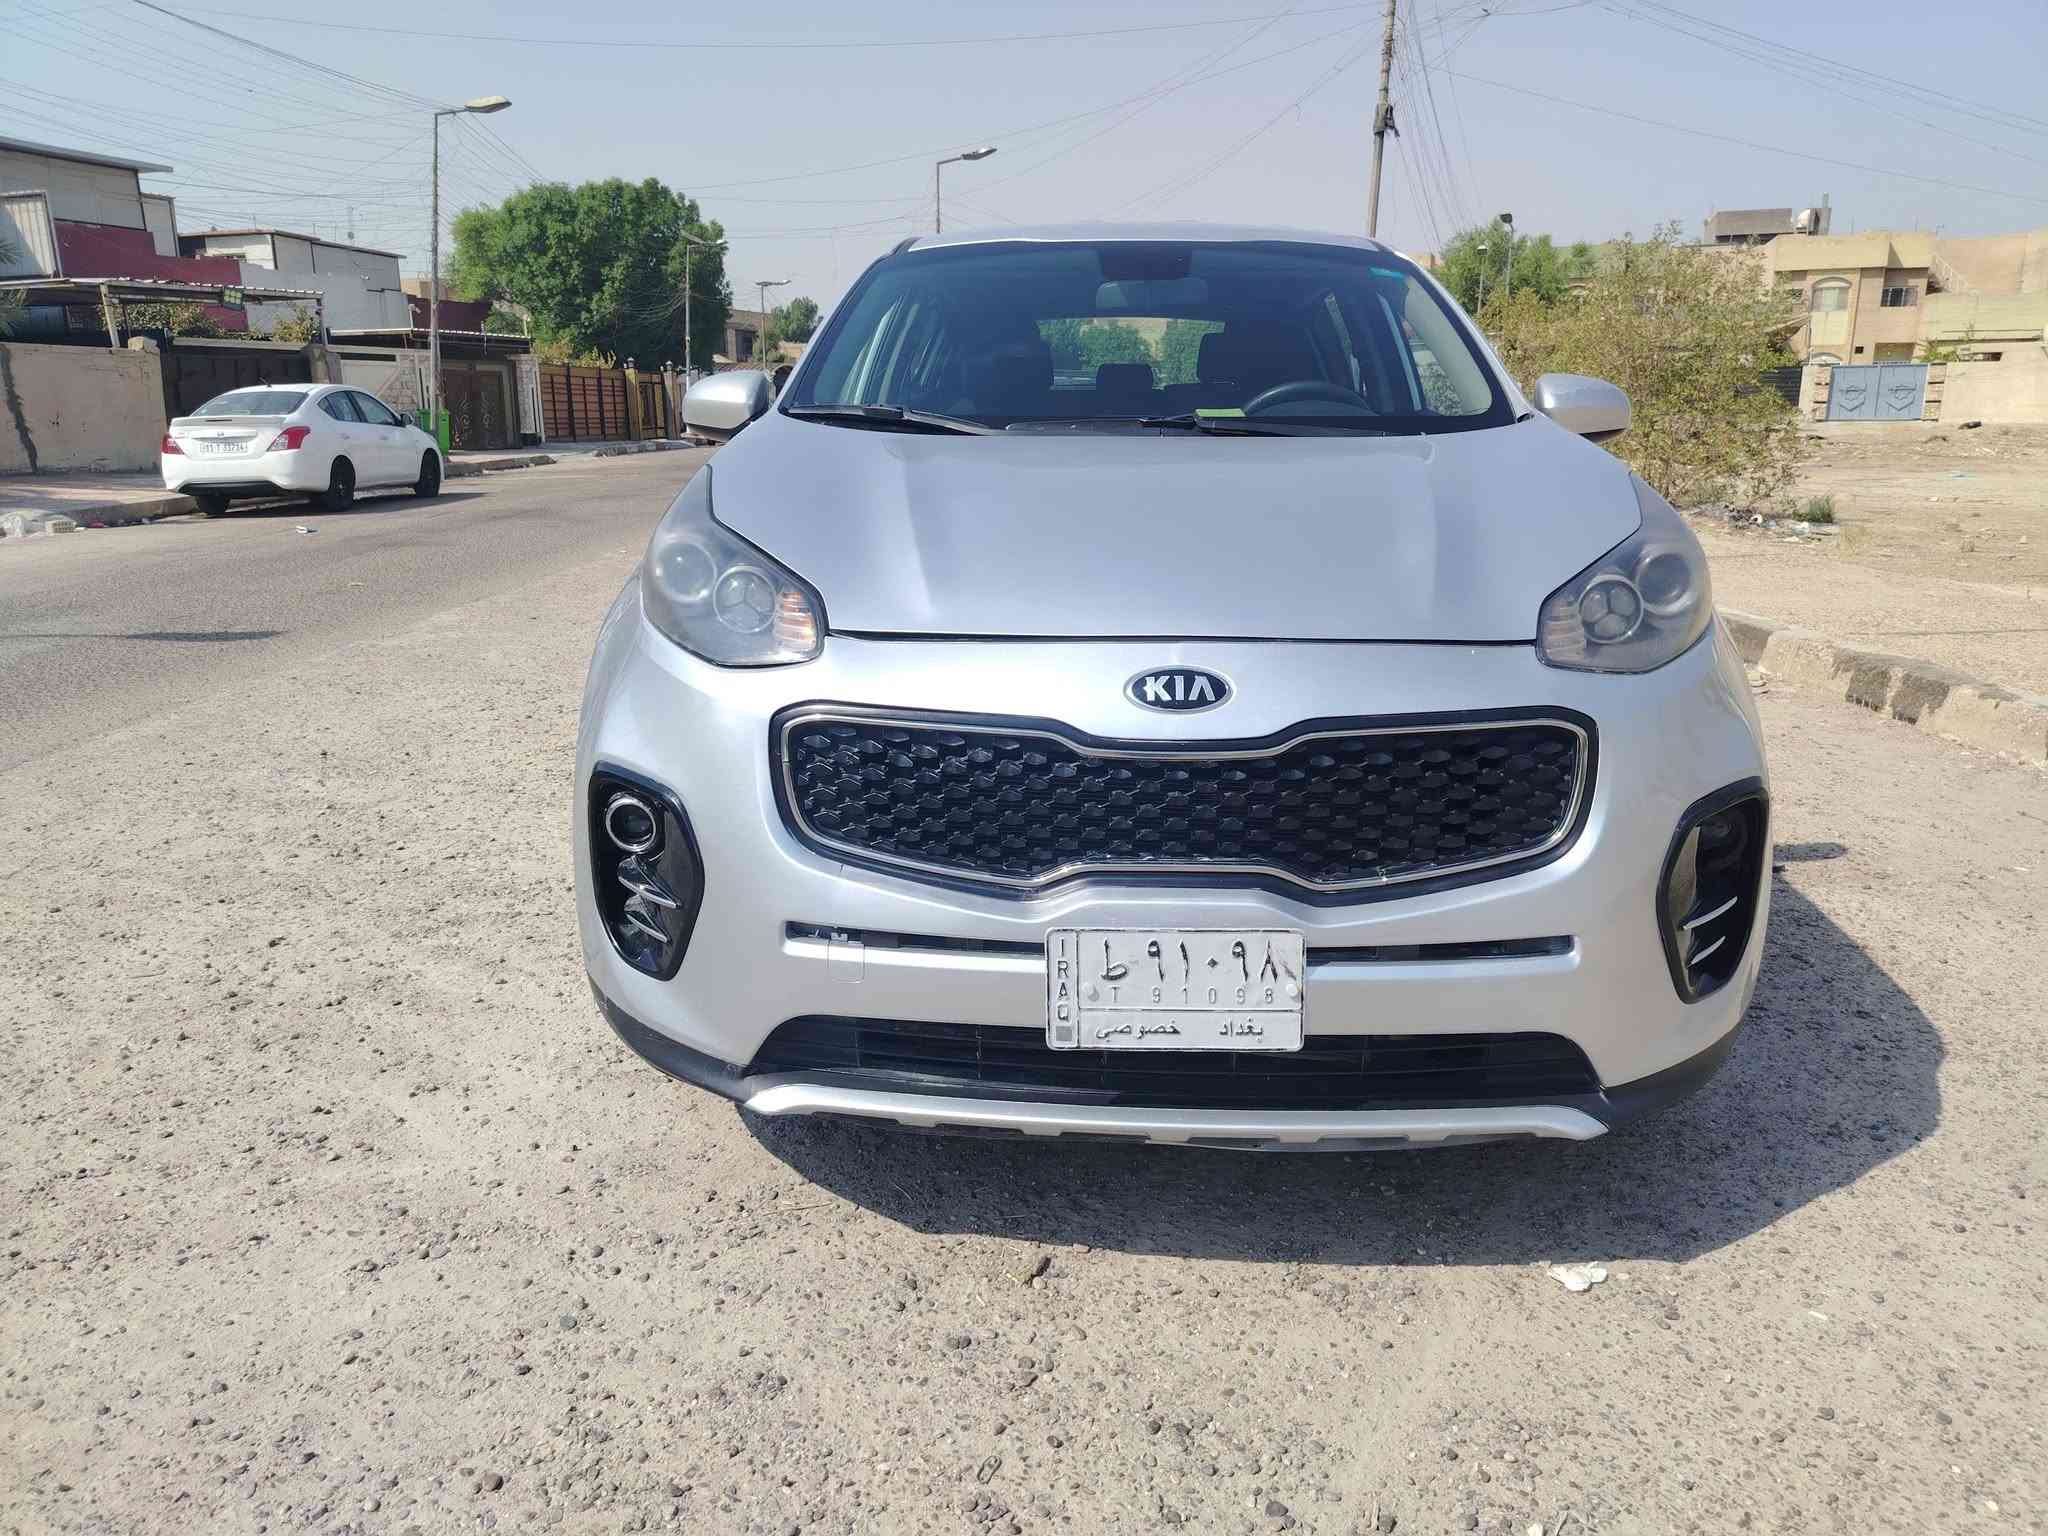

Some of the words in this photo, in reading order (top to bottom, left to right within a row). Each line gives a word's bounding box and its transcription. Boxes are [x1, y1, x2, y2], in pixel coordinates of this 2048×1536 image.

[1142, 674, 1216, 702] KIA
[1057, 939, 1069, 1022] IRAQ
[1095, 1018, 1181, 1043] خصوصي
[1218, 1018, 1264, 1043] بغداد
